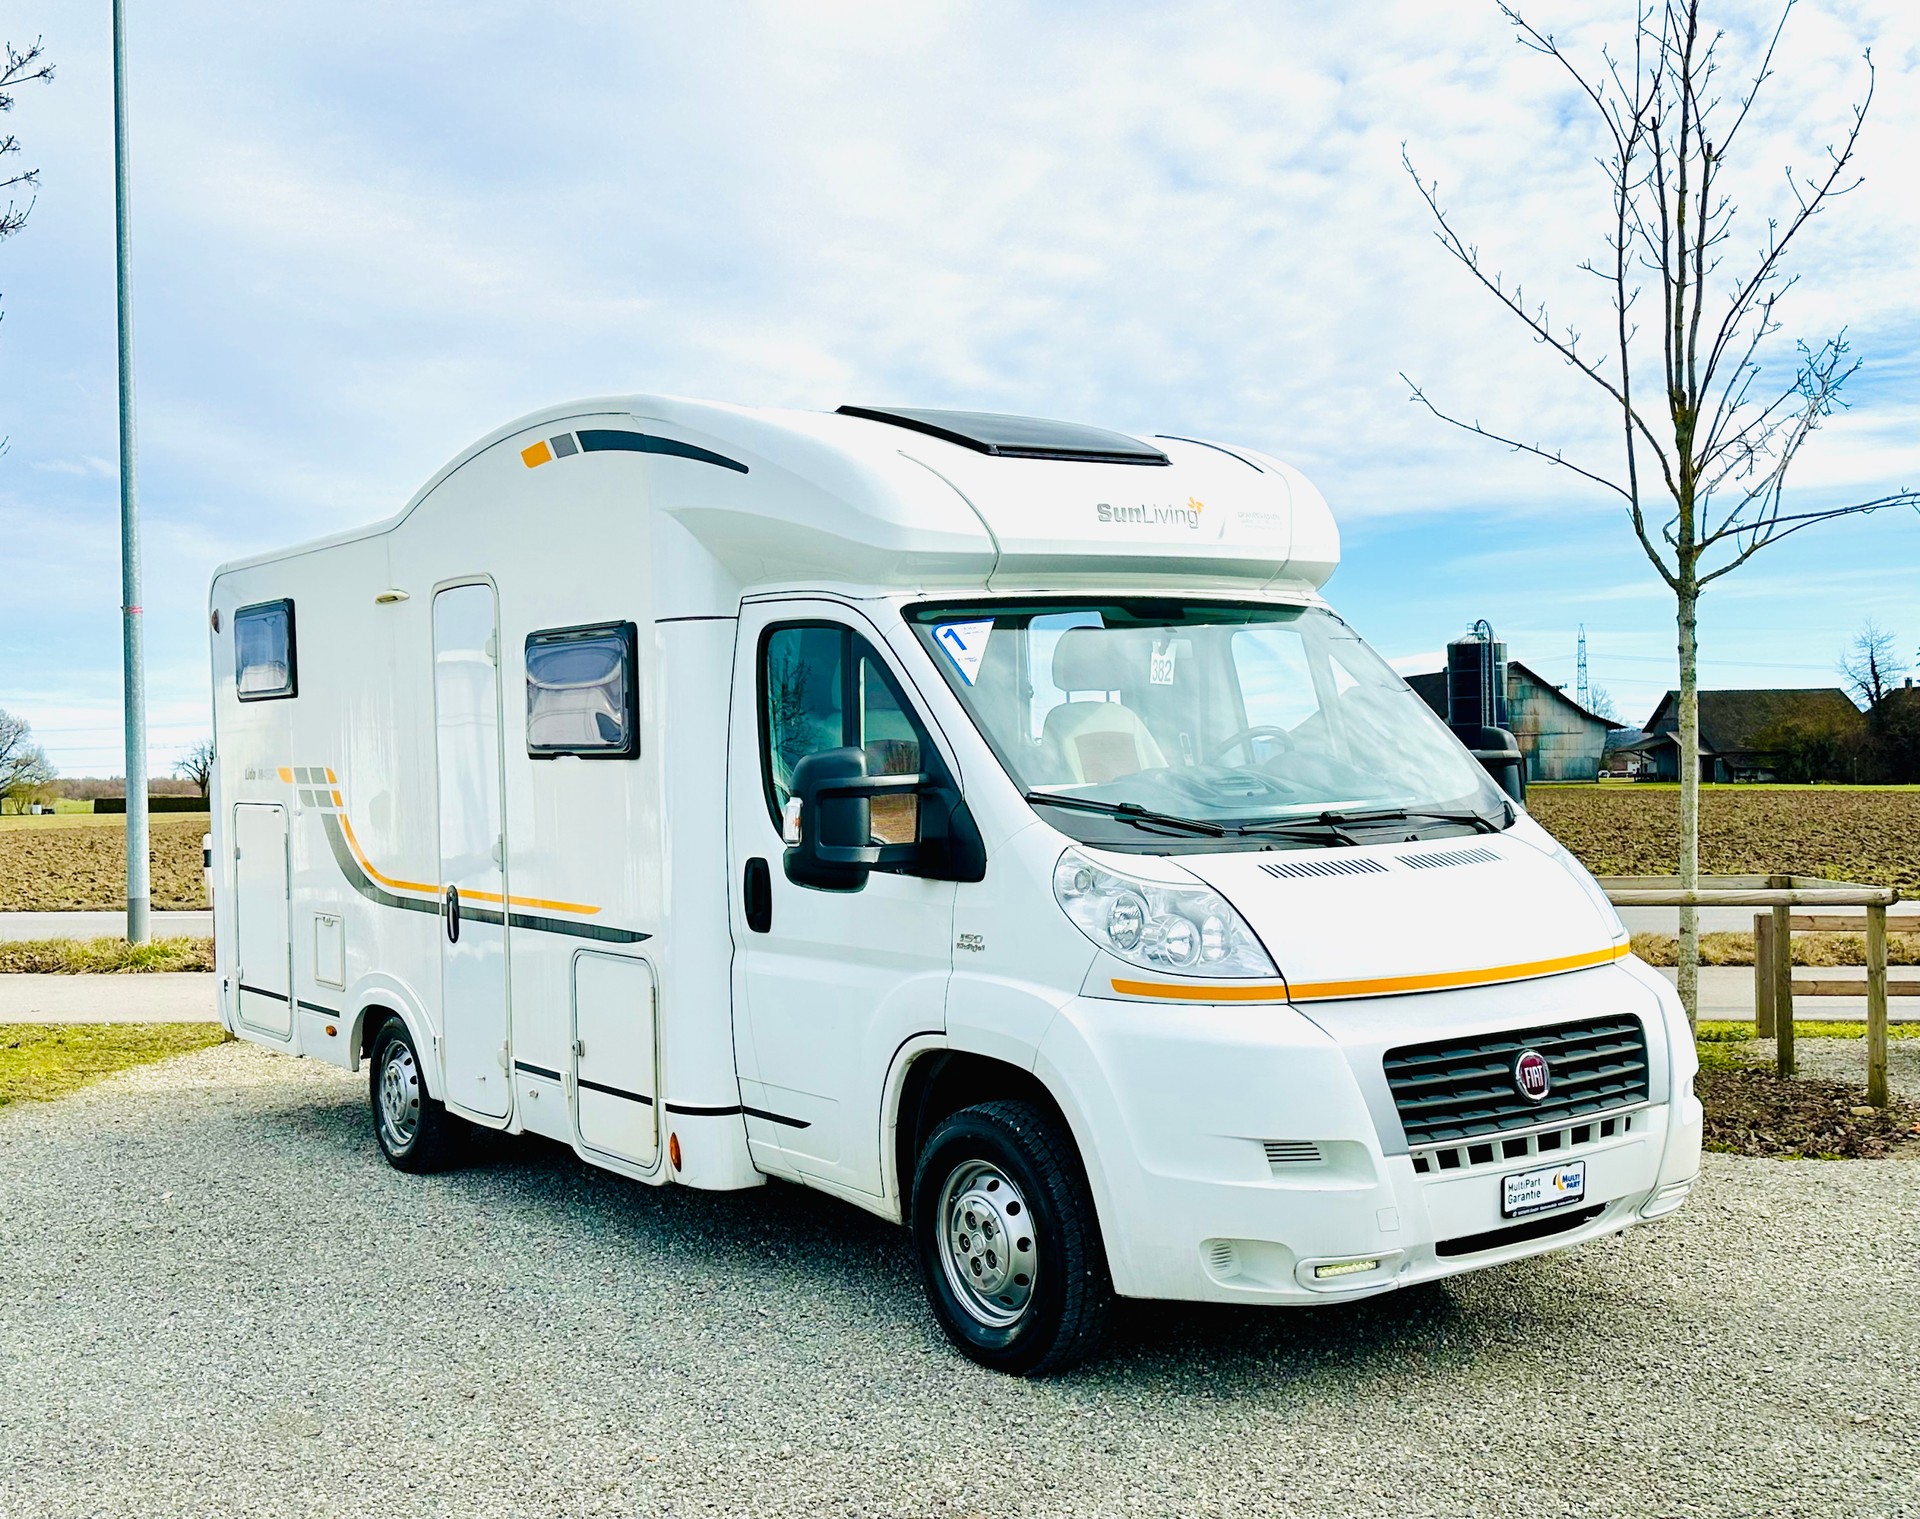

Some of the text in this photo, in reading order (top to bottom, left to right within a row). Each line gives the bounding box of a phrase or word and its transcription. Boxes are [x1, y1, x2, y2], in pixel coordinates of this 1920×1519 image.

[1097, 503, 1199, 529] SunLiving
[943, 628, 967, 650] 1
[1152, 659, 1172, 682] 382
[1524, 1065, 1544, 1088] FIAT
[1508, 1178, 1541, 1193] MultiPart
[1566, 1180, 1581, 1190] PART
[1508, 1190, 1541, 1205] Garantie
